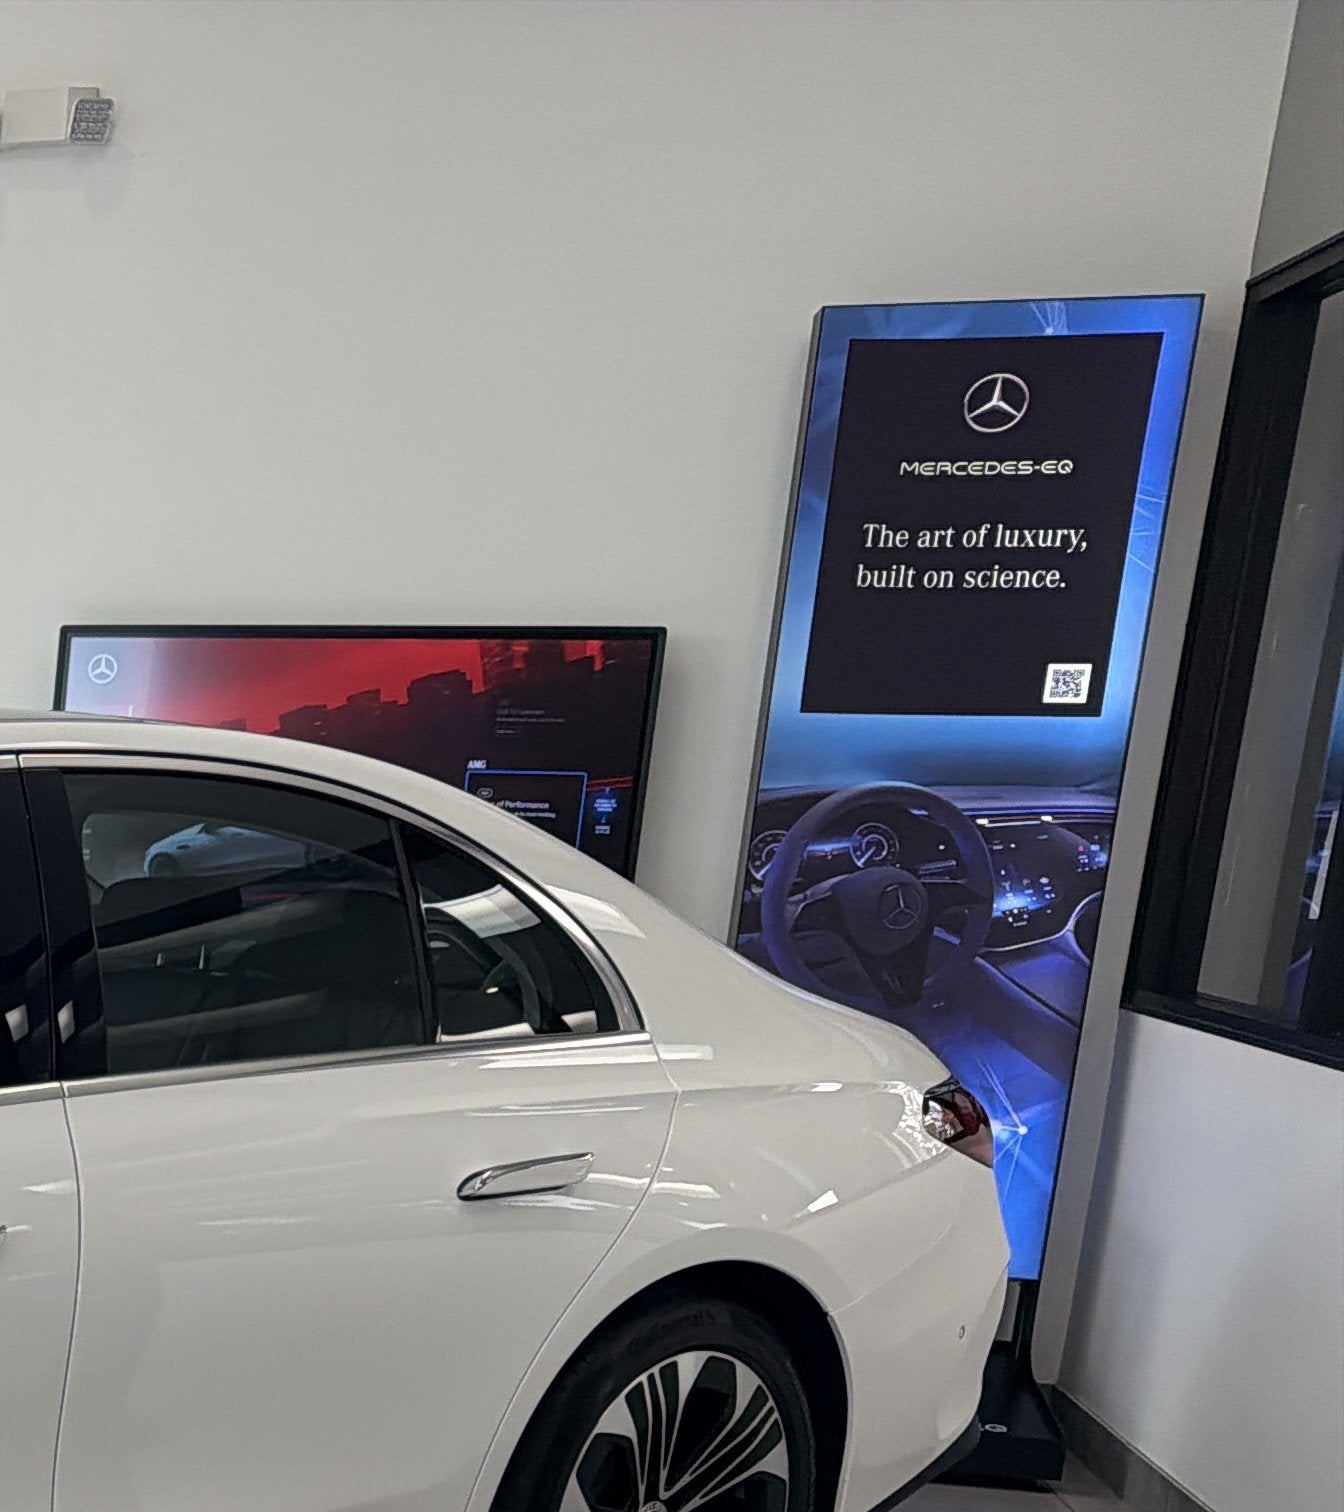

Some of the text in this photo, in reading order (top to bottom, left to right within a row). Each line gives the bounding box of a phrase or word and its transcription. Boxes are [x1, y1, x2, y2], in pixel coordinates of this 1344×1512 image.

[899, 459, 1074, 476] MERCEDES-EQ
[863, 523, 1087, 552] The art of luxury,
[856, 563, 1066, 589] built on science.
[467, 759, 487, 769] AMG
